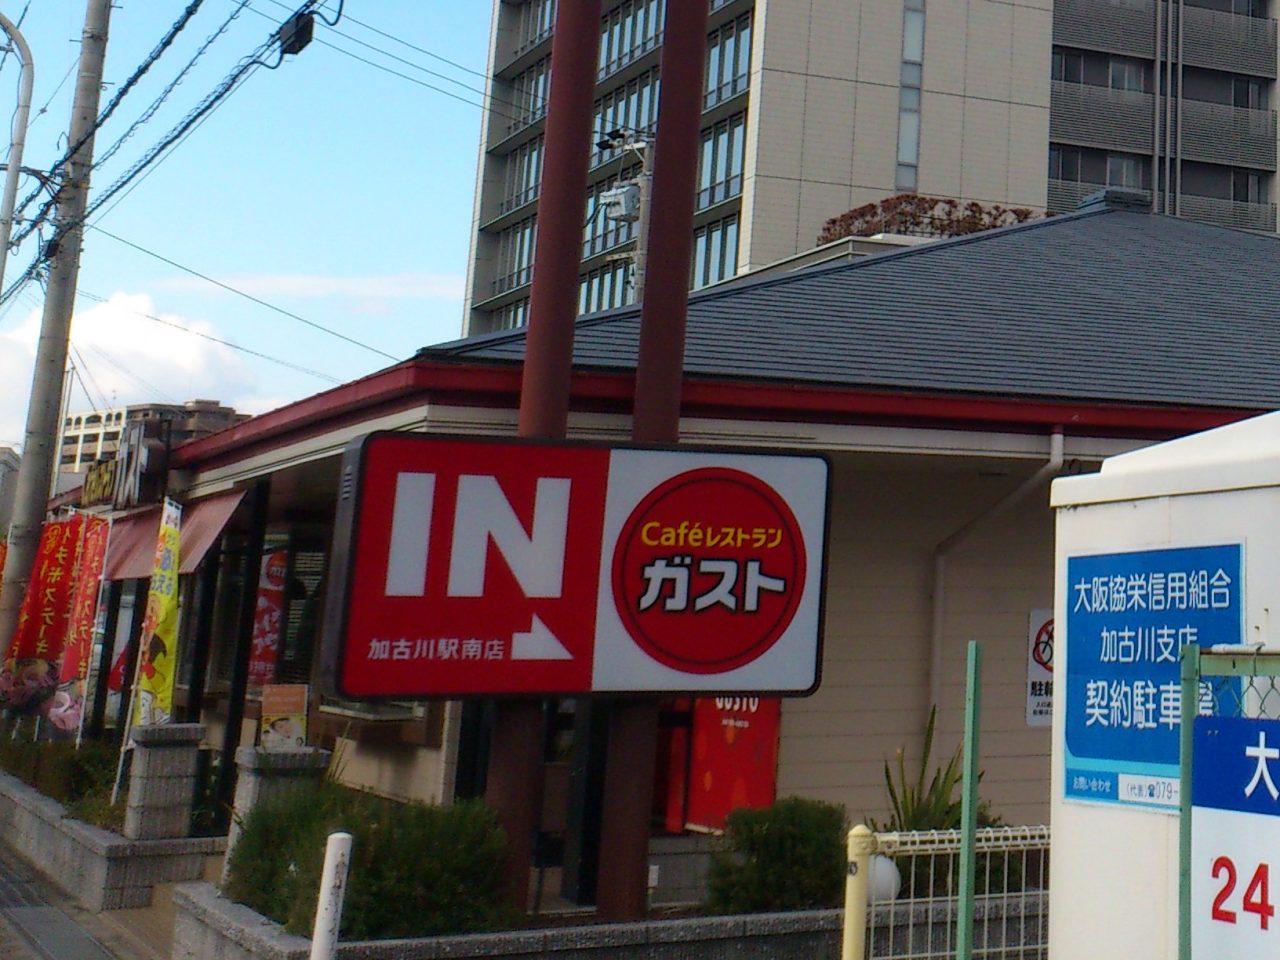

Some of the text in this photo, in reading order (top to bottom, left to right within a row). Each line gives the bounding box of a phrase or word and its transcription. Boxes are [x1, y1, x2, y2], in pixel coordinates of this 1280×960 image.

[385, 472, 572, 599] IN
[639, 555, 787, 613] ガスト
[1073, 568, 1232, 614] 大阪協栄信用組合
[367, 638, 505, 660] 加古川駅南店
